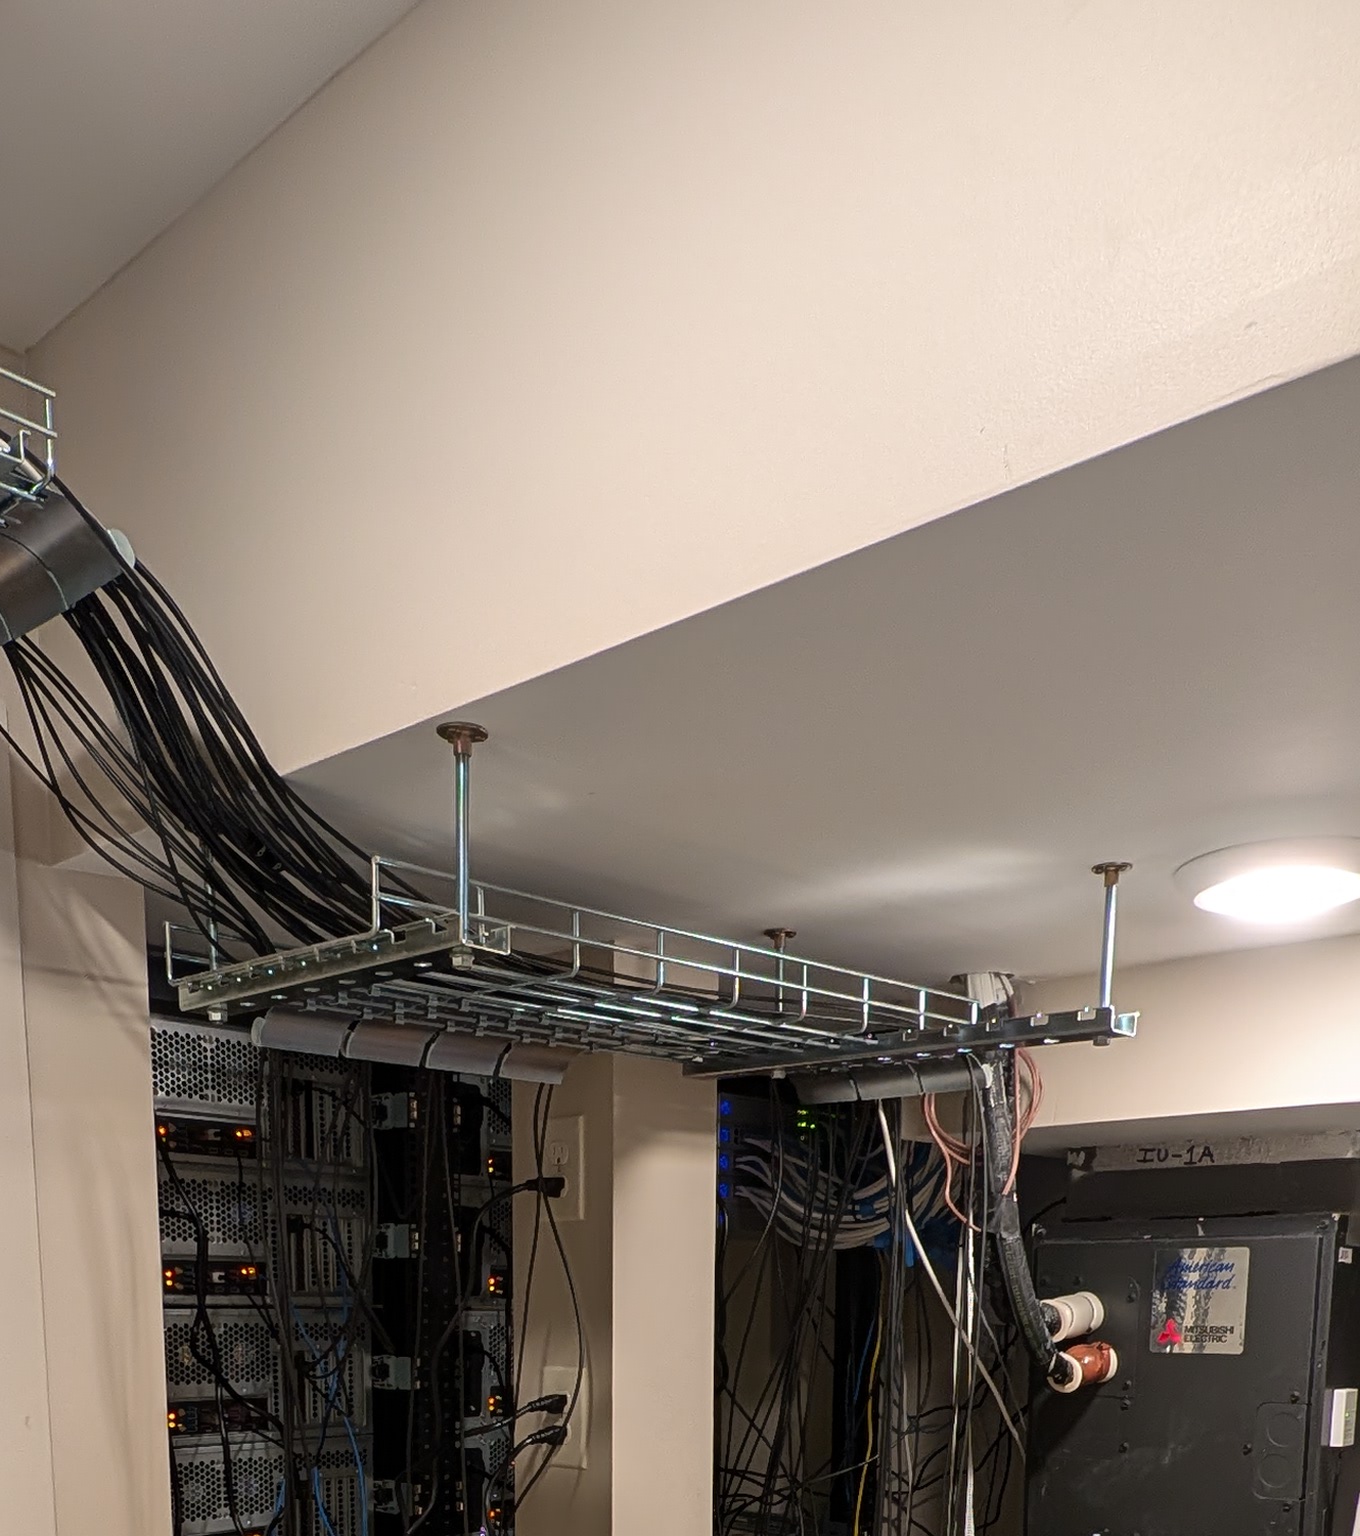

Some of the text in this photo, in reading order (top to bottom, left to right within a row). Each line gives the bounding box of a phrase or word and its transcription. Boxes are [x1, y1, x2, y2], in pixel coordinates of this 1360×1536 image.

[1137, 1145, 1215, 1165] IU-1A
[1167, 1258, 1235, 1274] American
[1162, 1273, 1234, 1291] Standard
[1184, 1325, 1235, 1335] MITSUBISHI
[1184, 1334, 1228, 1343] ELECTRIC
